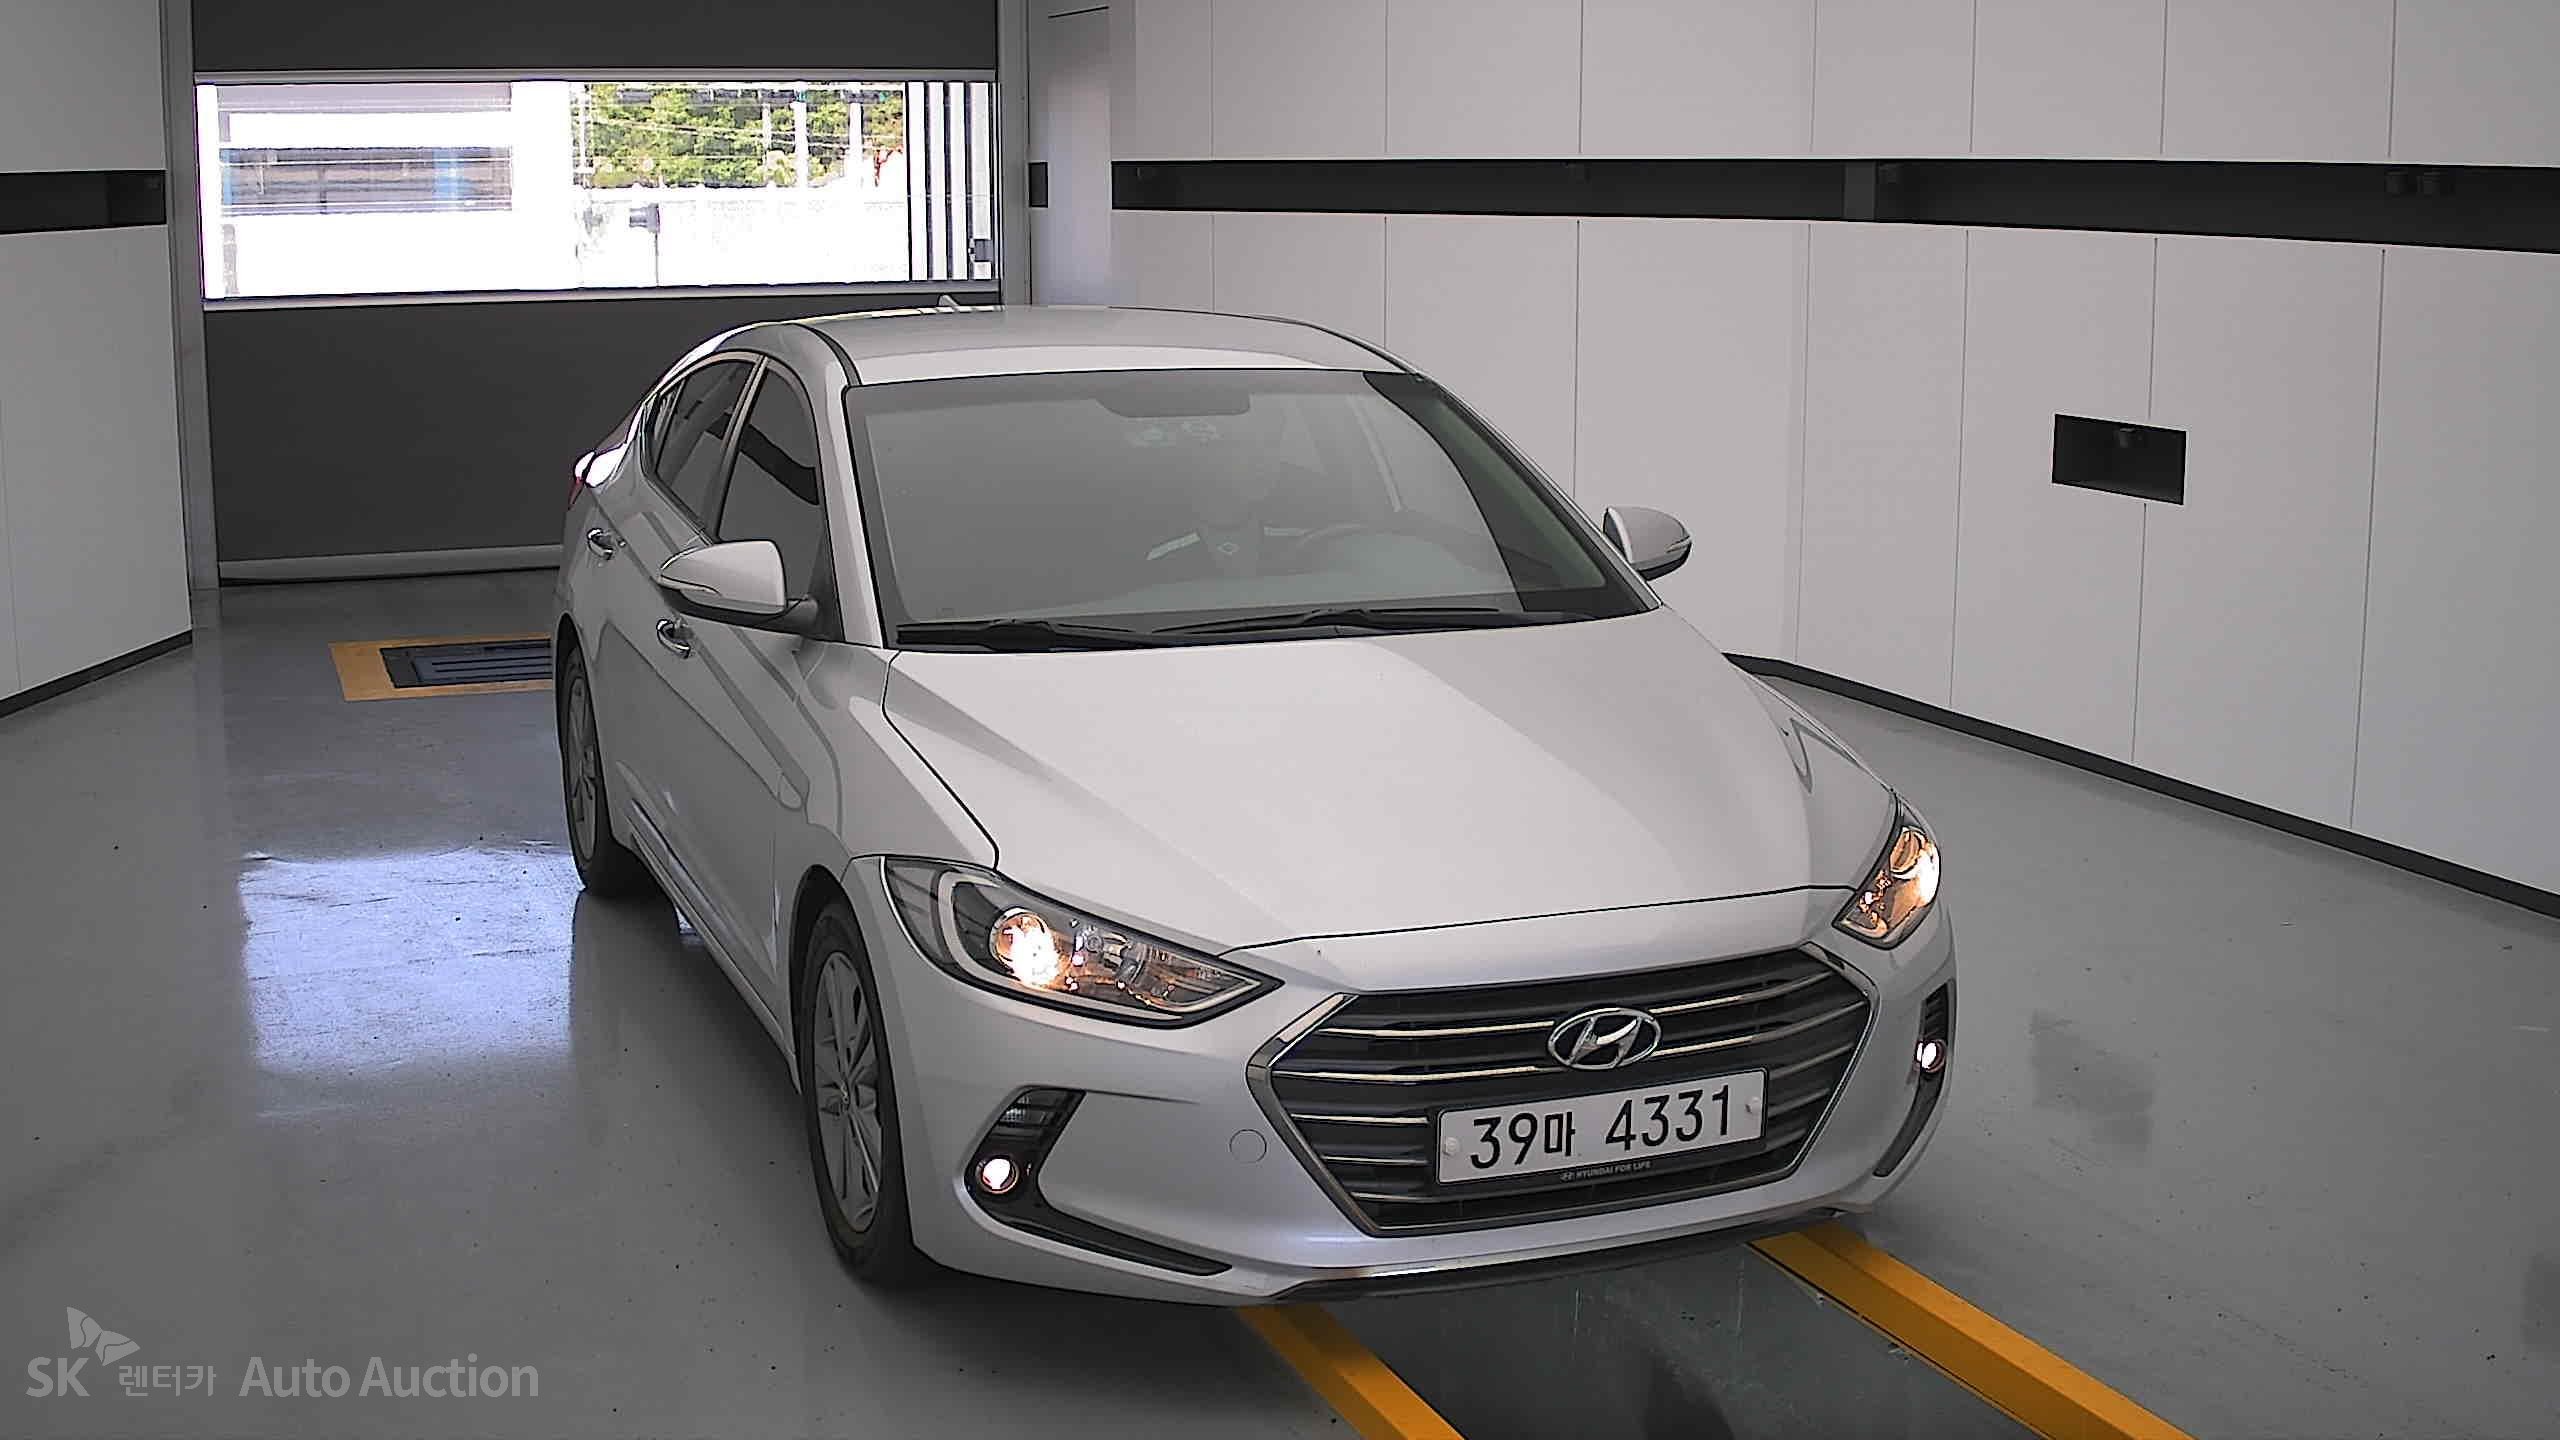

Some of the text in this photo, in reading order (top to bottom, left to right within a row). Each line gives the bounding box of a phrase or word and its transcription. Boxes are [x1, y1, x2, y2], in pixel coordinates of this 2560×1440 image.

[1470, 1084, 1730, 1169] 39마 4331
[1576, 1165, 1613, 1179] HYUNDAI
